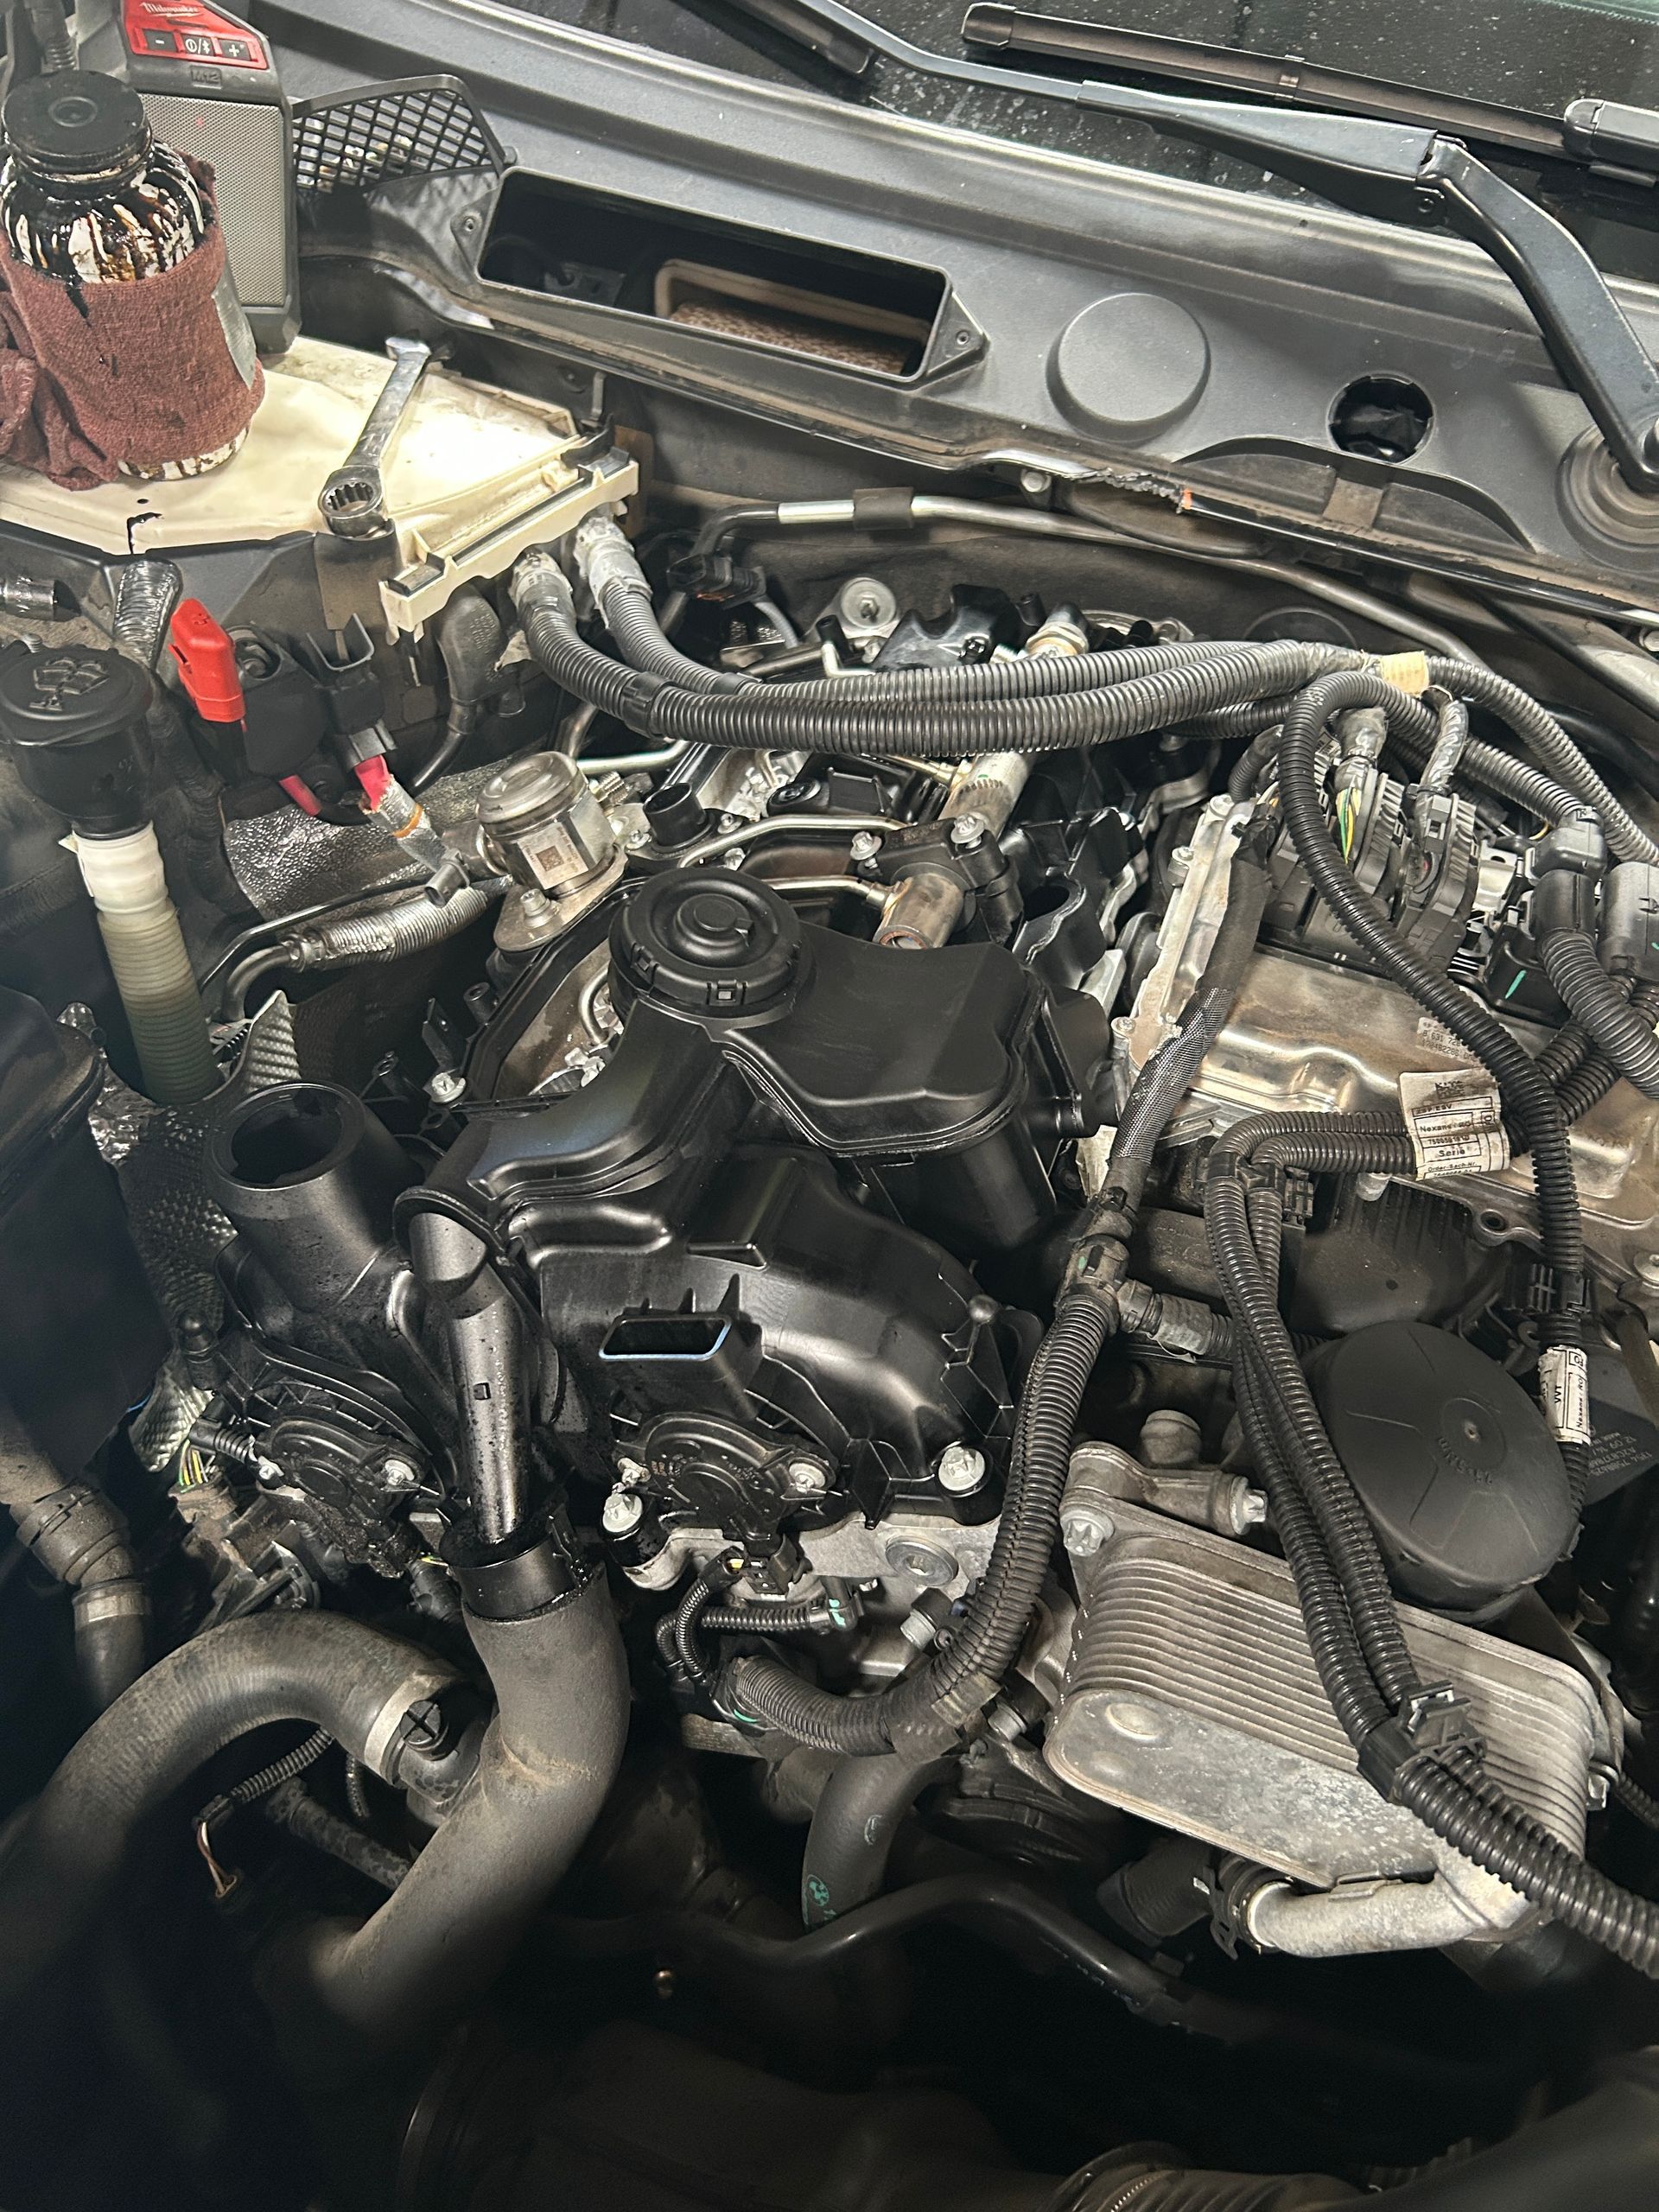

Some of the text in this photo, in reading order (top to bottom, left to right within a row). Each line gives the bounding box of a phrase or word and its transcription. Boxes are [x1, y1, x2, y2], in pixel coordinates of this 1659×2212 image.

[139, 2, 199, 14] Milwaukee
[192, 70, 219, 84] M12
[1439, 1148, 1465, 1157] Serie
